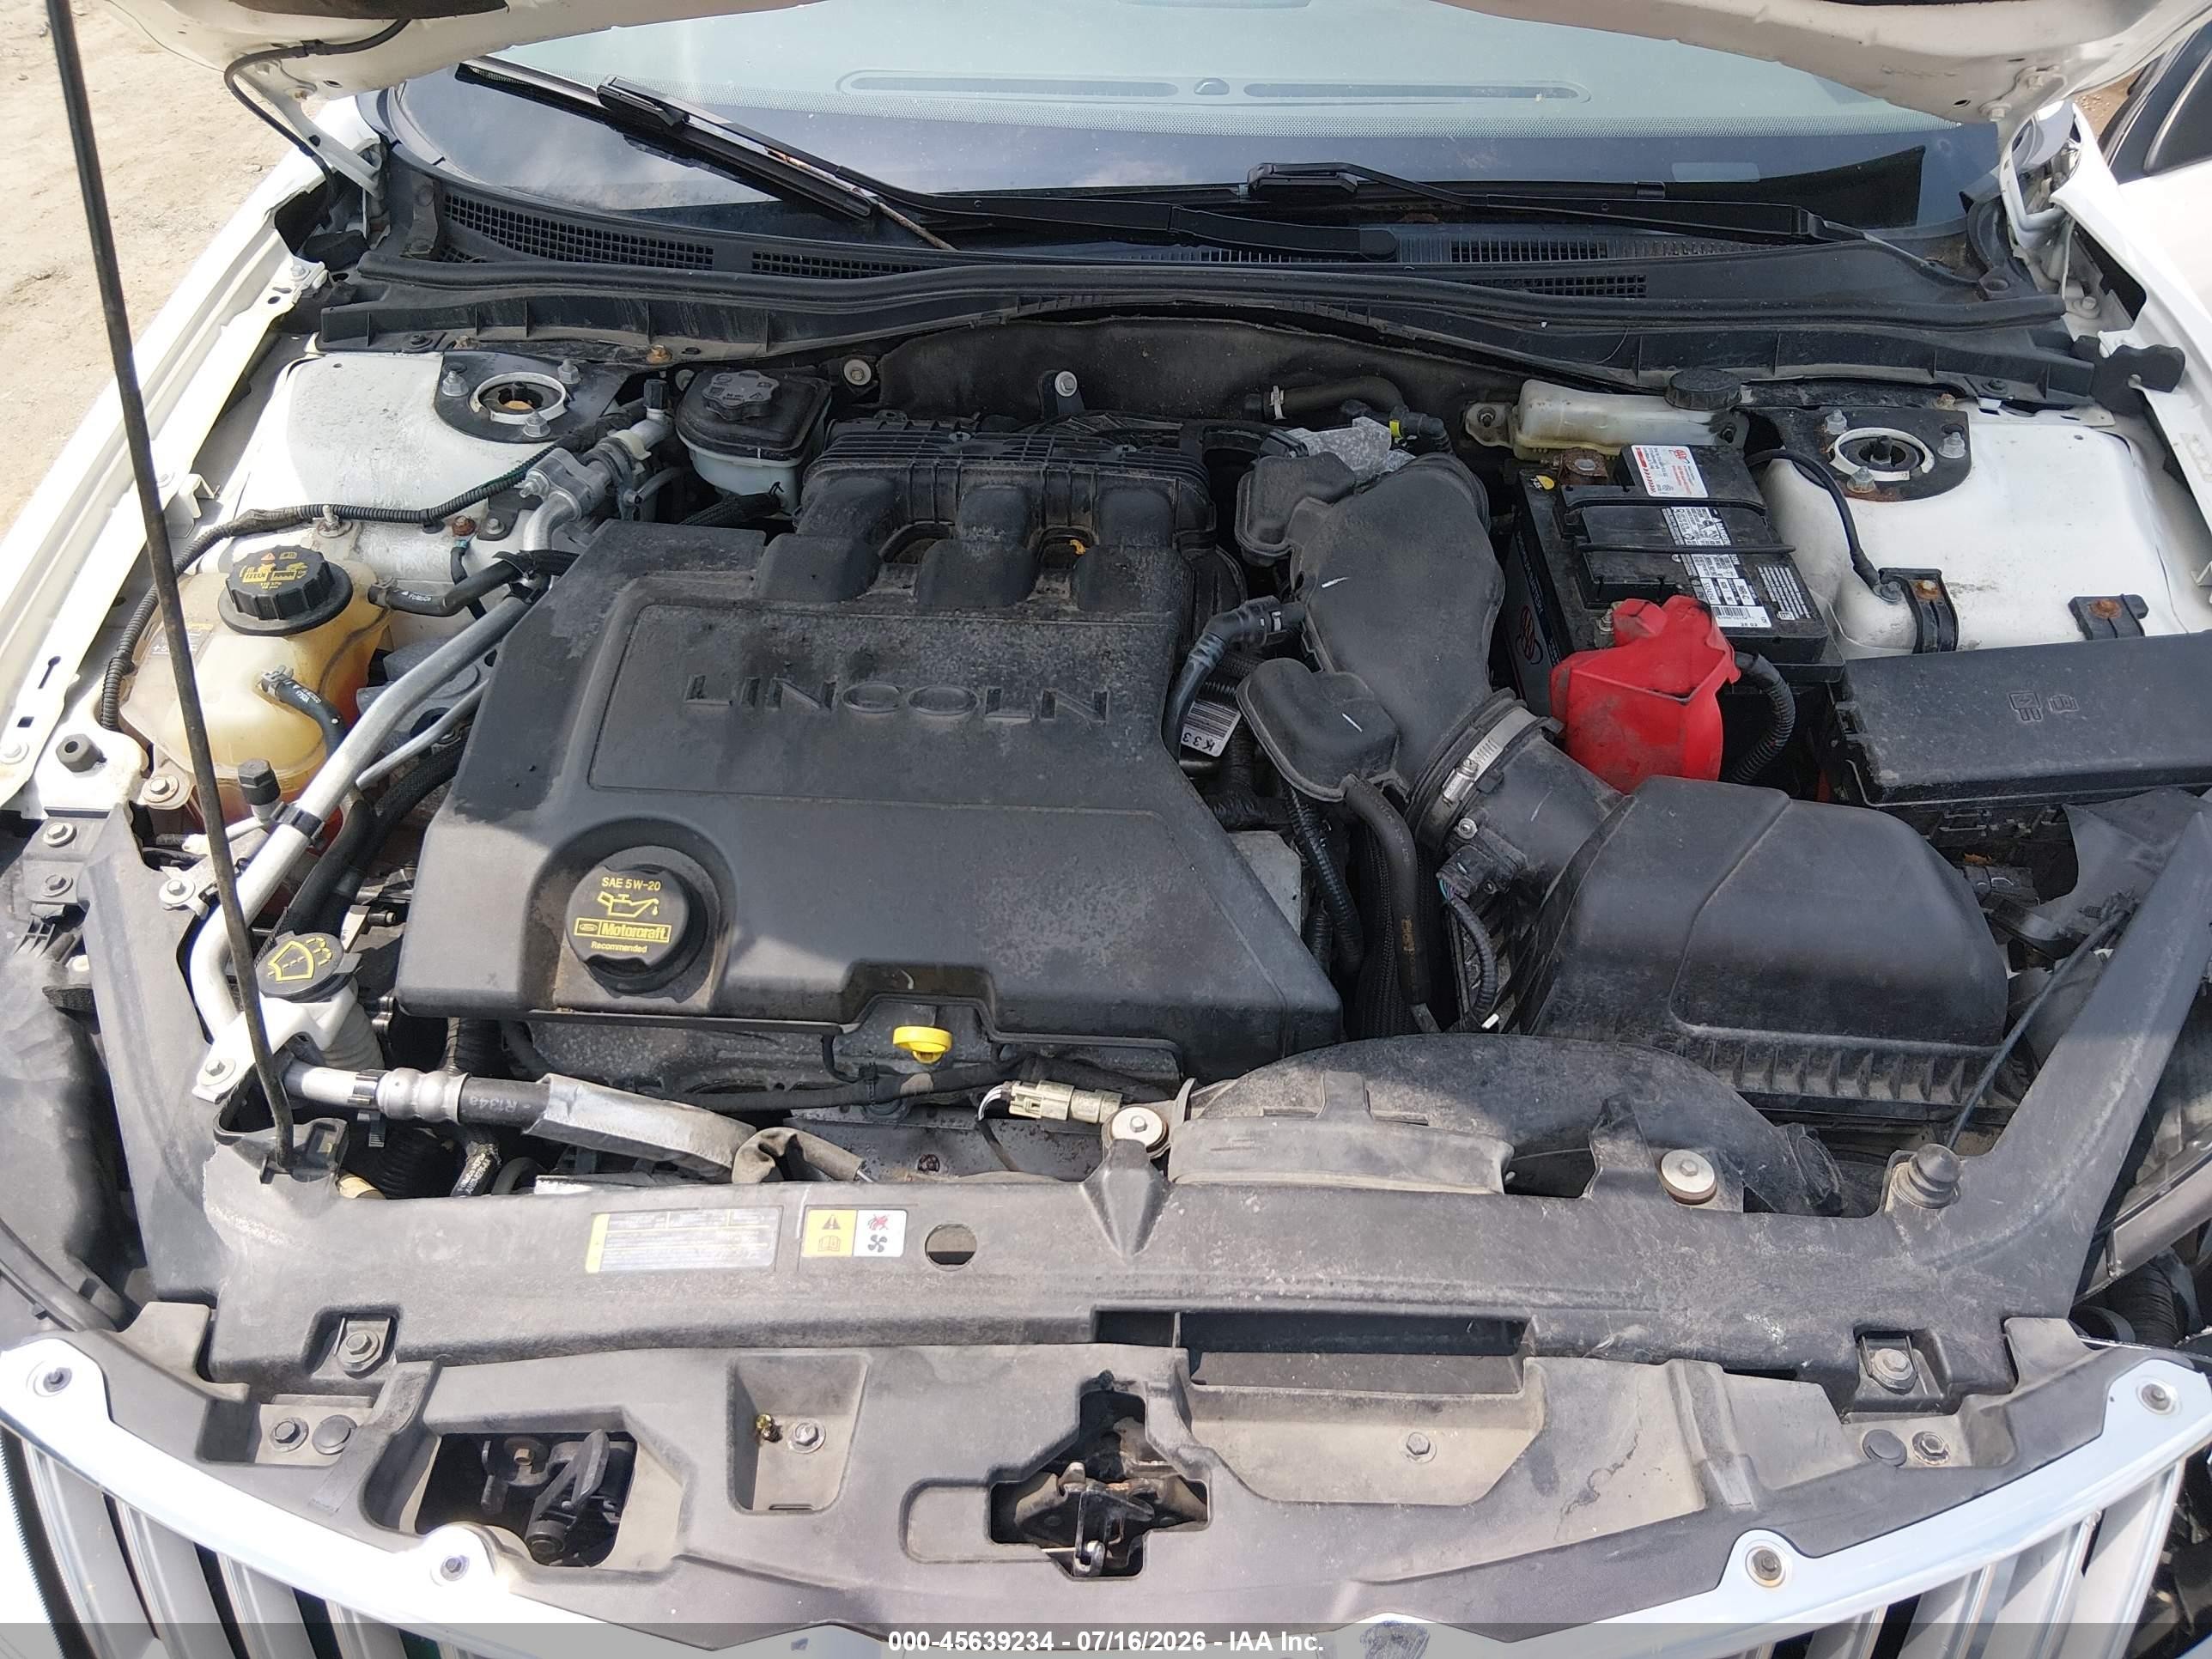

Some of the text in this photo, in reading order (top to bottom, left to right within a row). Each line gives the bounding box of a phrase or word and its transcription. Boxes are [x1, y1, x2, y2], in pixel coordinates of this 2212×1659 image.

[684, 673, 1109, 723] LINCOLN
[602, 877, 661, 891] SAE 5W-20
[601, 922, 668, 940] Motorcraft
[591, 941, 647, 953] Recommended
